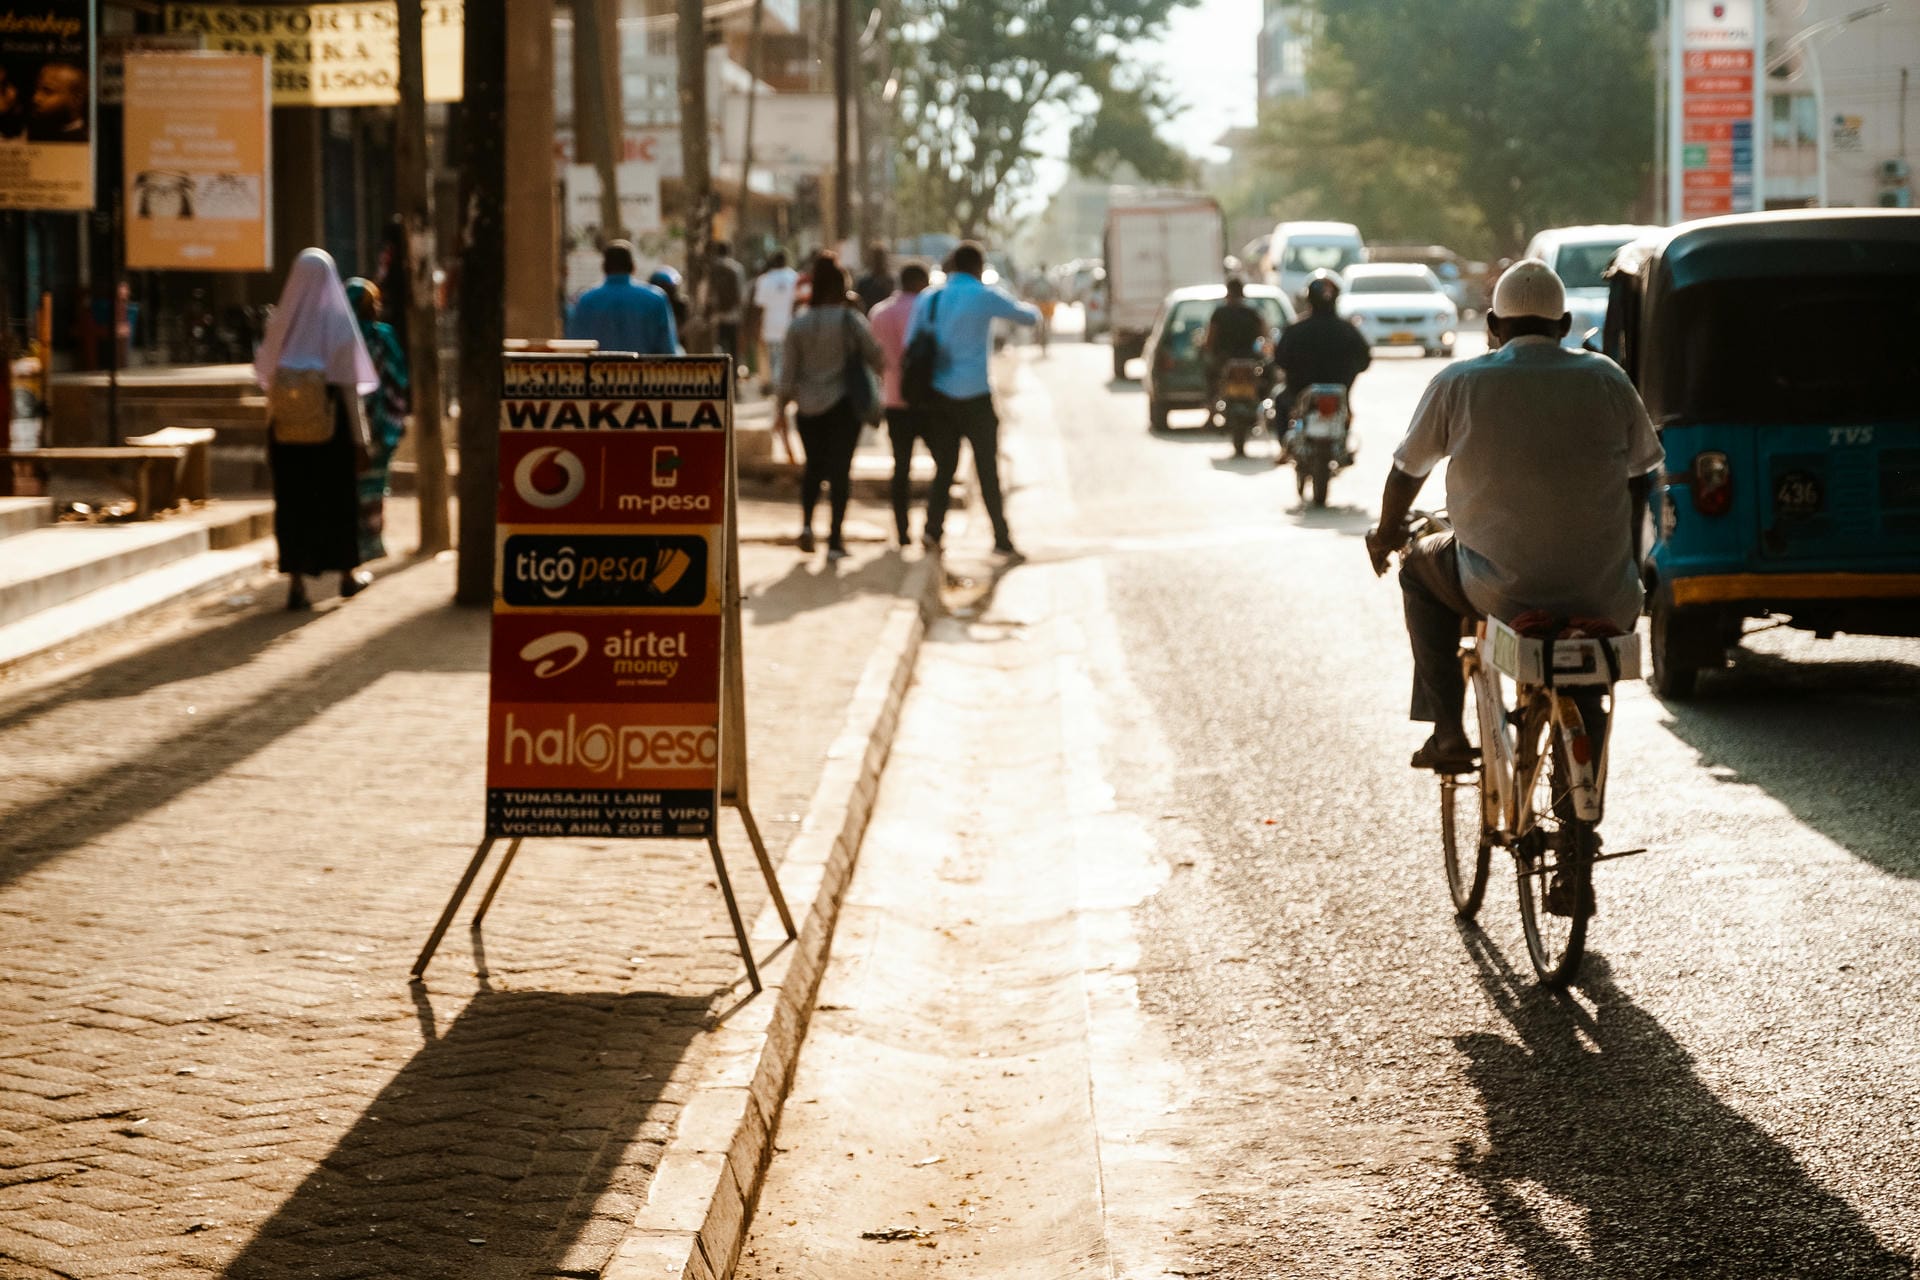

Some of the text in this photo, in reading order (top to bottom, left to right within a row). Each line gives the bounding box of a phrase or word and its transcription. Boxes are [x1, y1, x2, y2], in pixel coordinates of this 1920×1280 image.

[506, 401, 722, 429] WAKALA
[1828, 426, 1874, 446] TVS
[618, 494, 710, 515] m-pesa
[577, 556, 648, 589] pesa
[603, 629, 688, 658] airtel
[613, 659, 679, 679] money
[503, 792, 662, 805] TUNASAJILI LAINI
[503, 808, 710, 820] VIFURUSHI VYOTE VIPO
[503, 823, 565, 834] VOCHA
[569, 823, 612, 834] AINA
[617, 823, 664, 834] ZOTE
